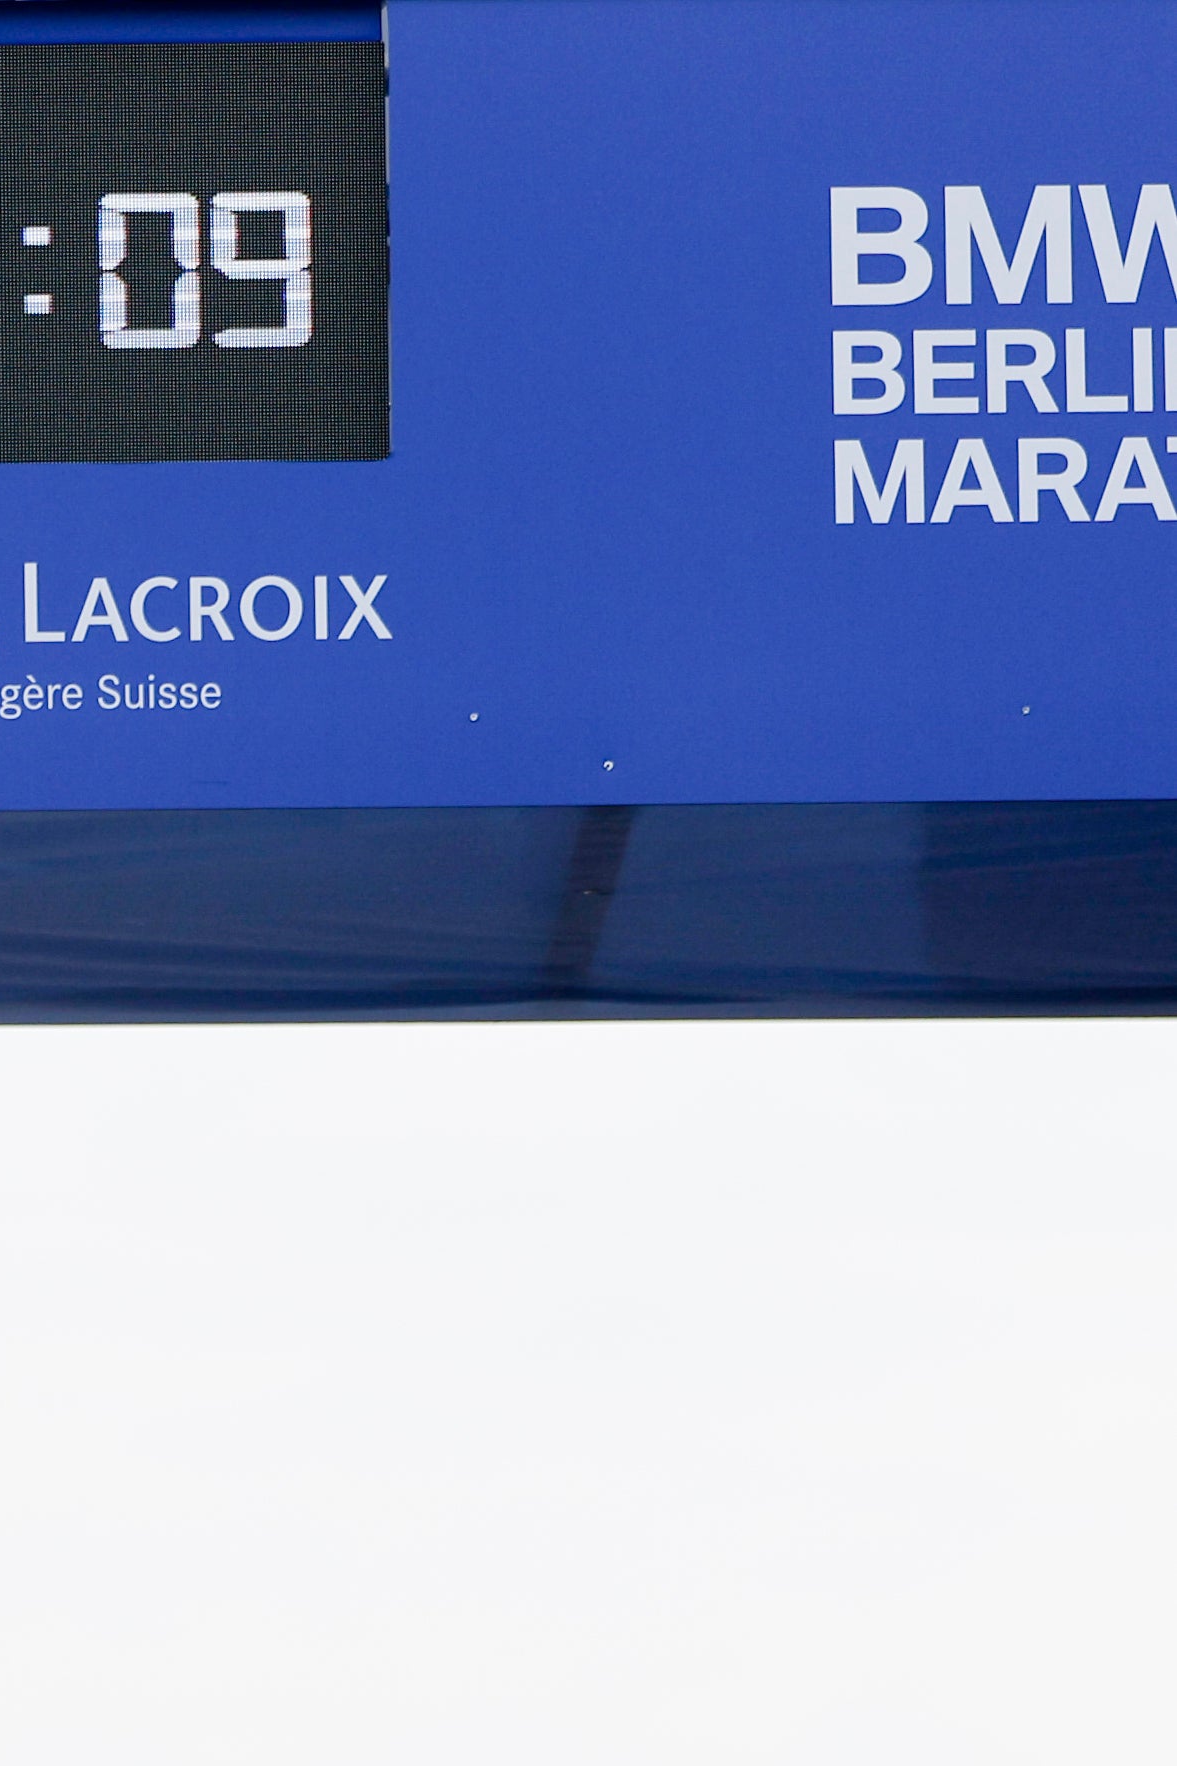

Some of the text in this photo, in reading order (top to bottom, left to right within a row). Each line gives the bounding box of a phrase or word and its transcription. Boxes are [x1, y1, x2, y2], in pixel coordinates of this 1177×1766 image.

[830, 184, 1177, 307] BMW
[833, 328, 1177, 416] BERLI
[835, 437, 1177, 525] MARA
[98, 675, 223, 711] Suisse
